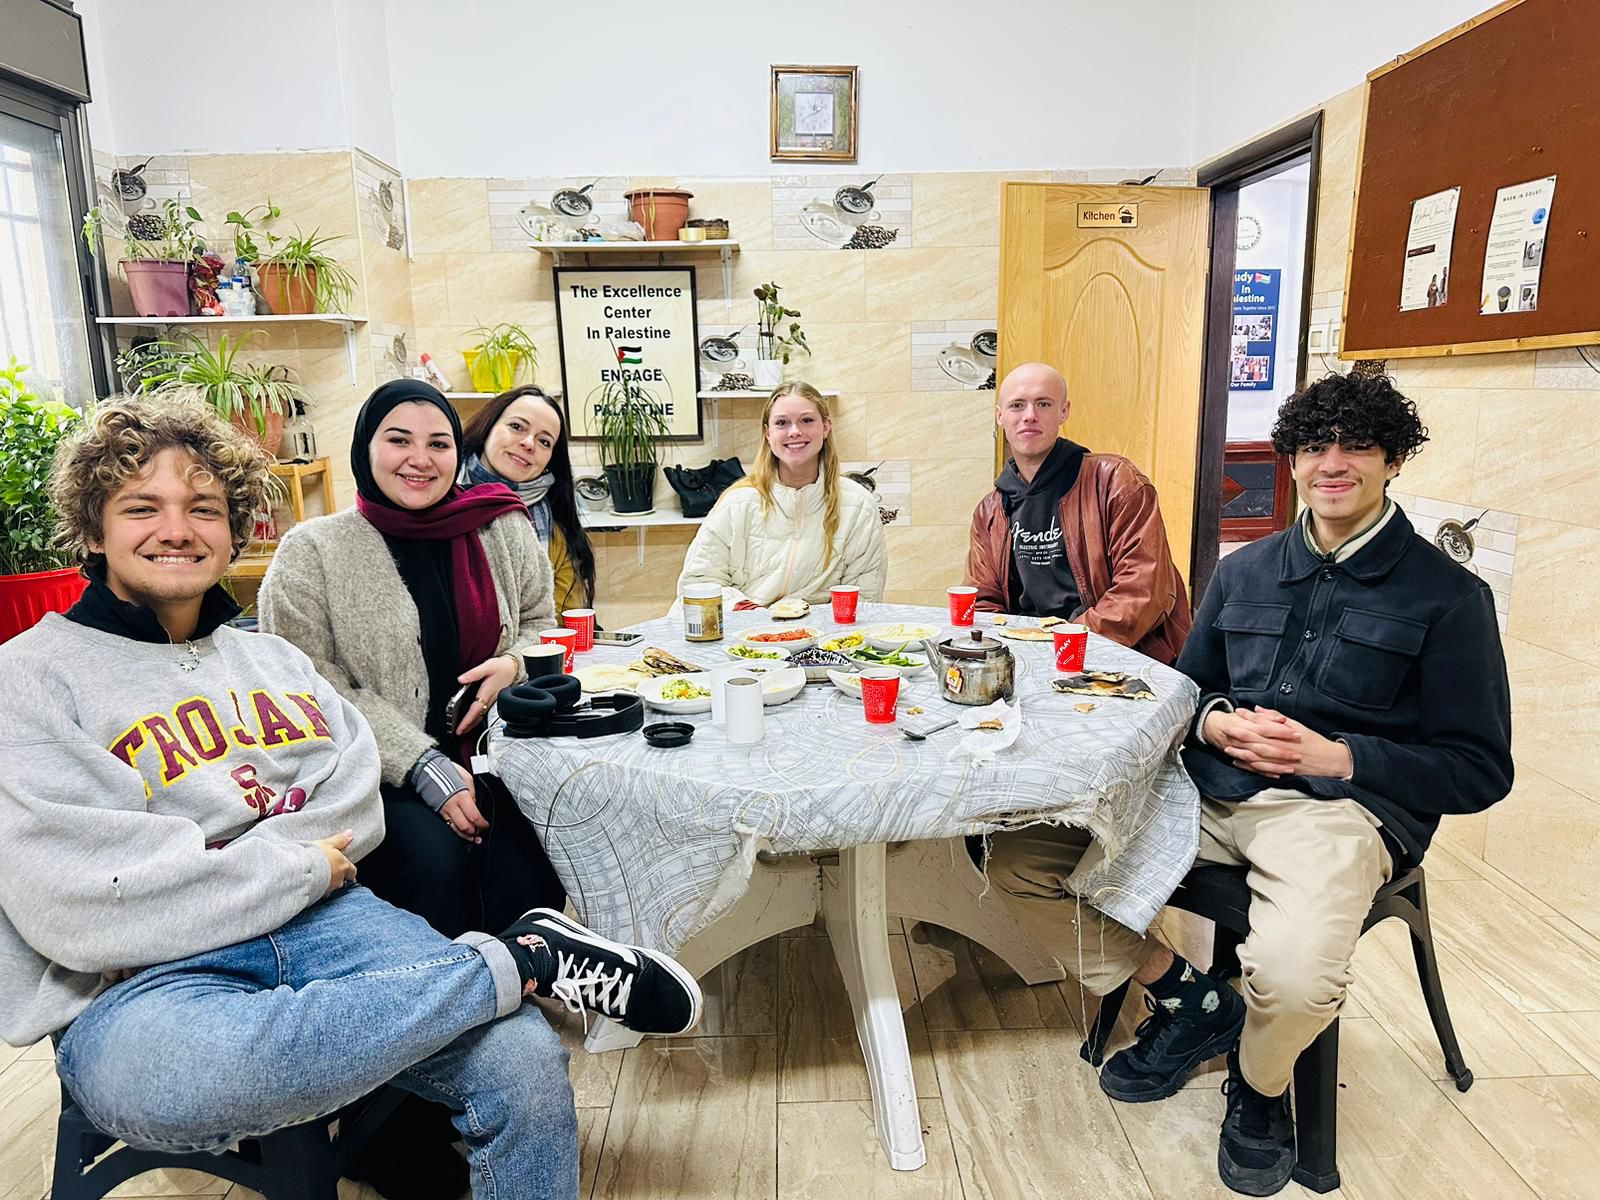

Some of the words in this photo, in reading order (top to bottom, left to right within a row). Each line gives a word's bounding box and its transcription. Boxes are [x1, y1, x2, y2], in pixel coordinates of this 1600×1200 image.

[1083, 210, 1116, 220] Kitchen
[570, 285, 598, 298] The
[602, 285, 682, 298] Excellence
[1241, 285, 1251, 294] In
[603, 305, 652, 318] Center
[586, 326, 600, 339] In
[605, 326, 671, 339] Palestine
[601, 369, 662, 381] ENGAGE
